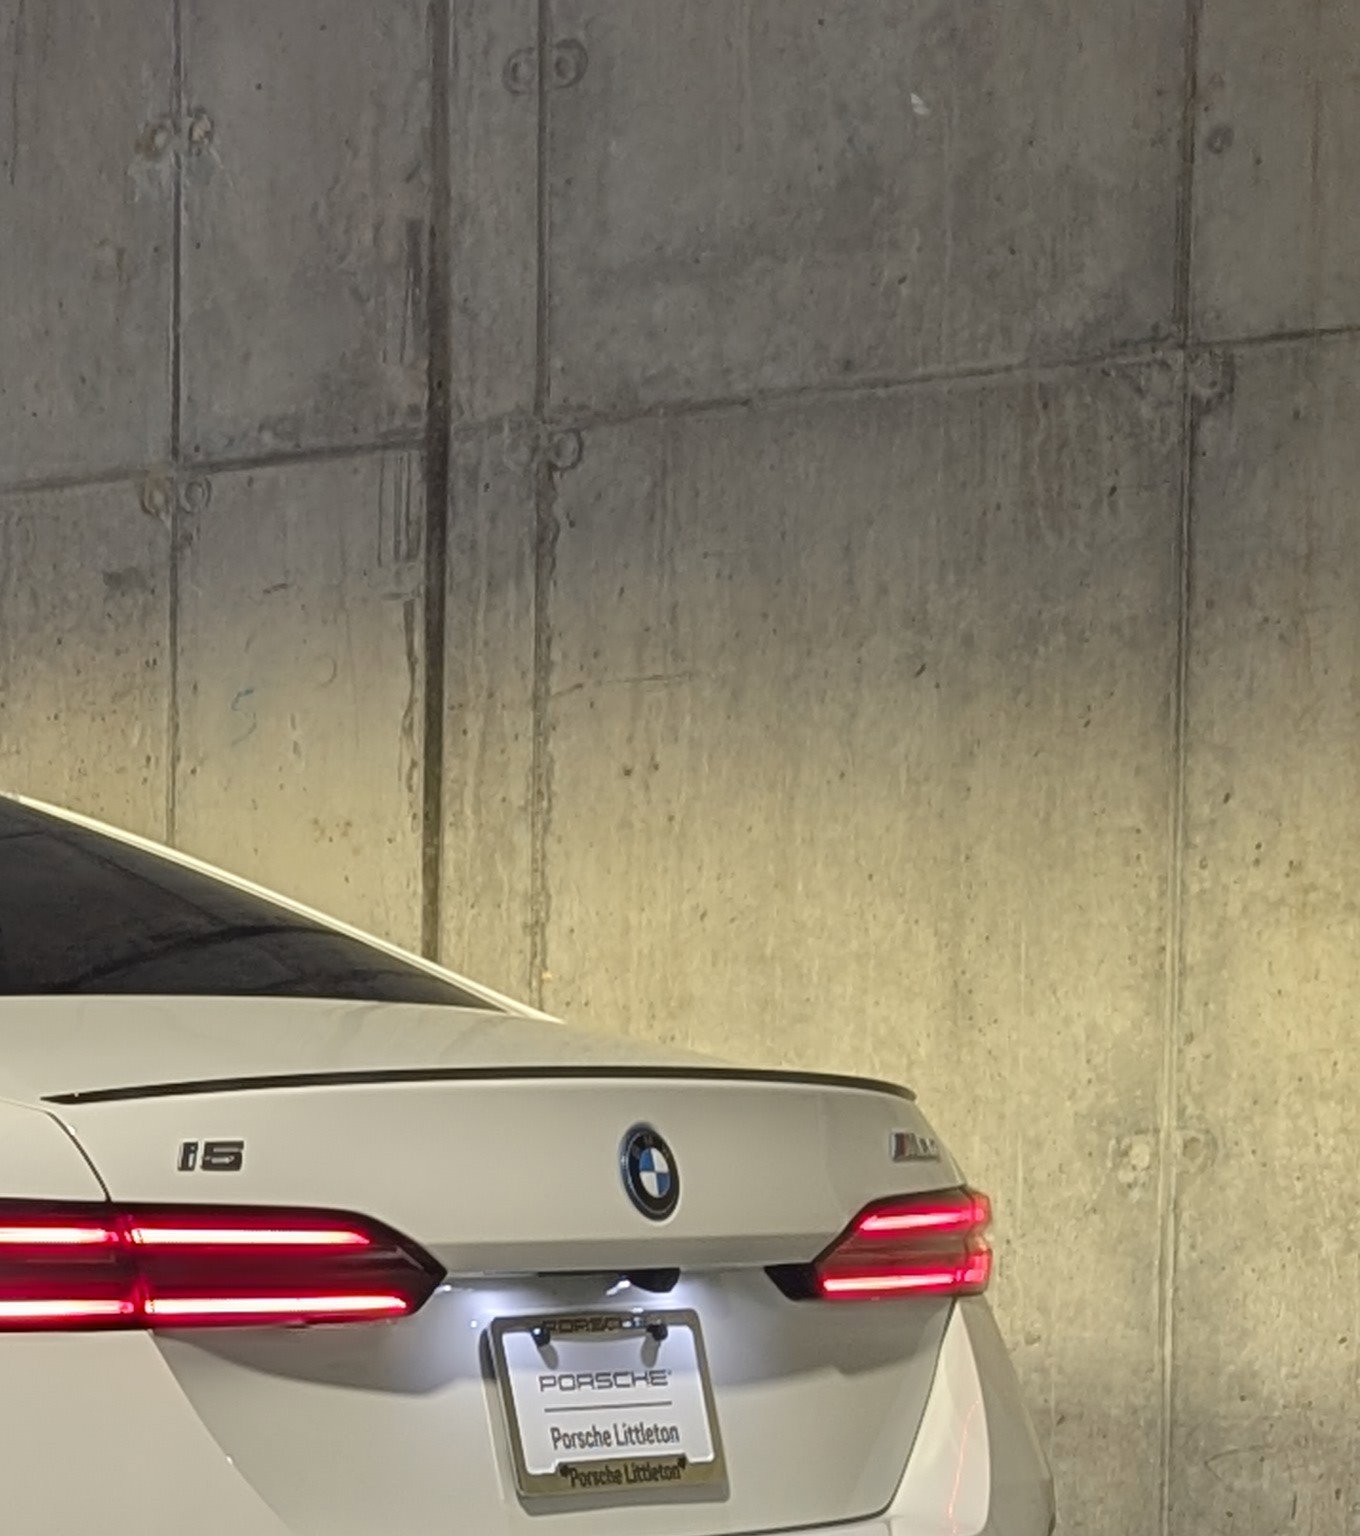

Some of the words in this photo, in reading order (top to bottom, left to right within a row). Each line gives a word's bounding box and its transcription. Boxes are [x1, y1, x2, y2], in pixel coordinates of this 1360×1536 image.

[178, 1140, 244, 1171] i5
[539, 1370, 670, 1392] PORSCHE
[550, 1425, 612, 1450] Porsche
[613, 1421, 680, 1447] Littleton
[570, 1465, 623, 1487] Porsche
[623, 1461, 681, 1484] Littleton
